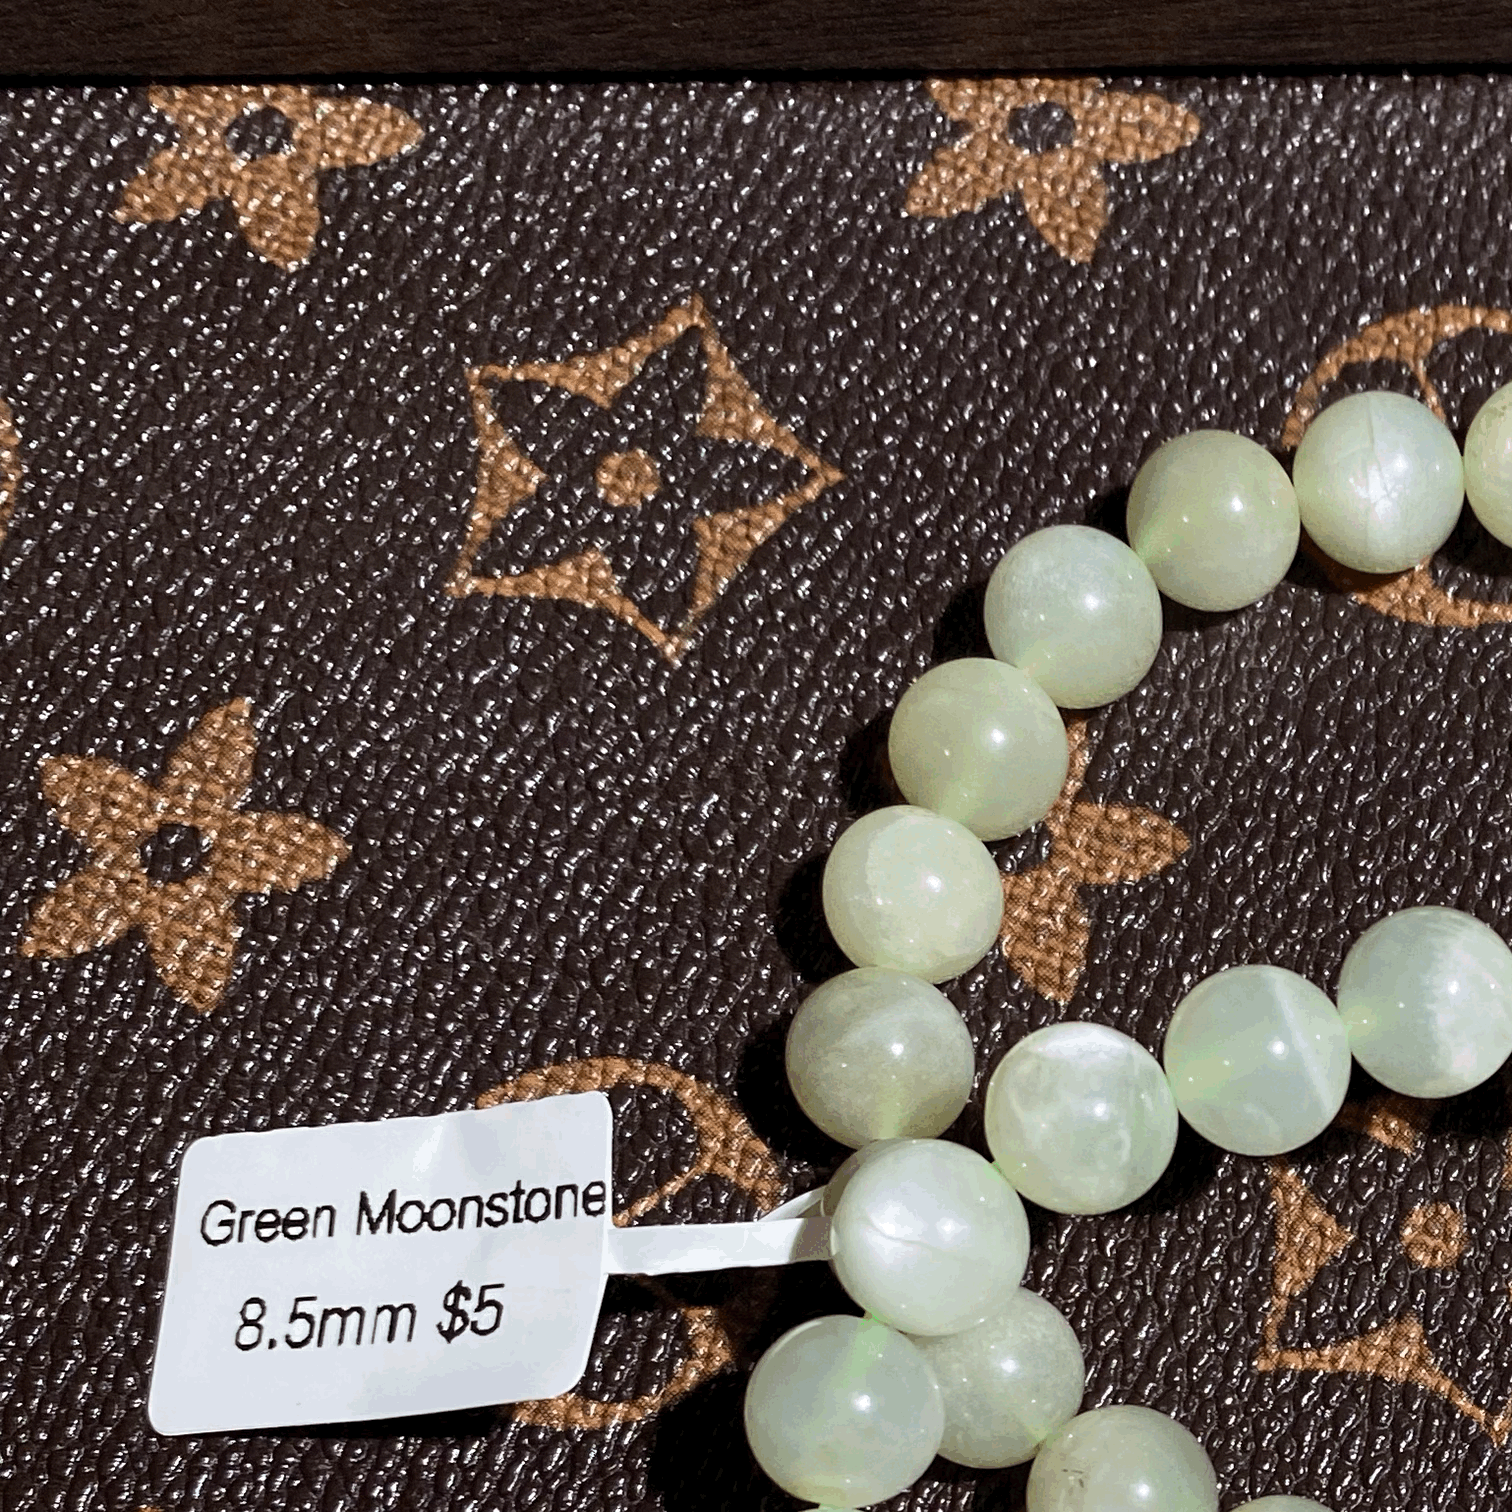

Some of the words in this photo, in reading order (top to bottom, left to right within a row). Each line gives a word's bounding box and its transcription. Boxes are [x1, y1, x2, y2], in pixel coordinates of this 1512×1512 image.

[199, 1199, 336, 1247] Green
[356, 1180, 606, 1236] Moonstone
[233, 1295, 418, 1352] 8.5mm
[434, 1280, 505, 1345] $5
